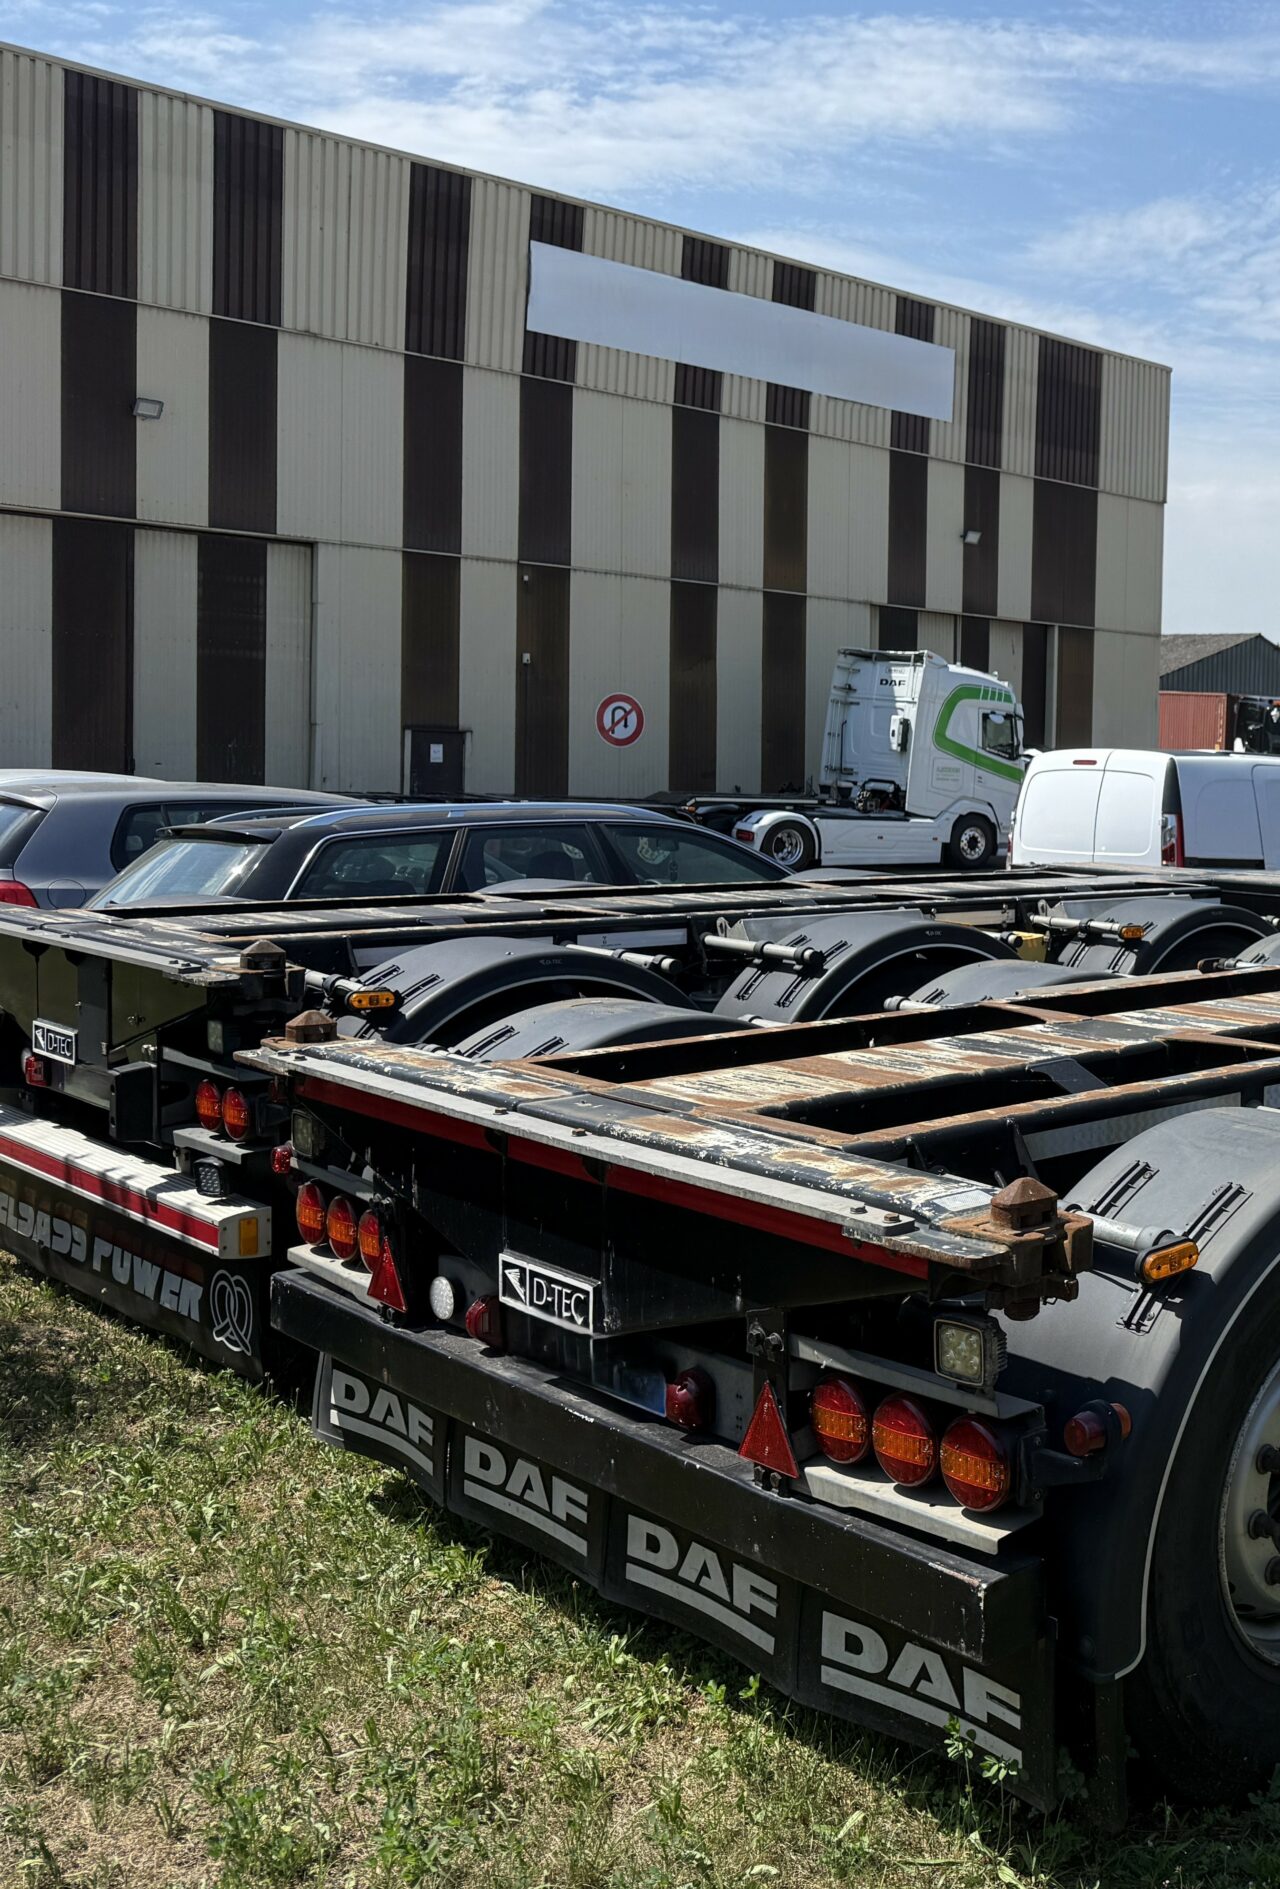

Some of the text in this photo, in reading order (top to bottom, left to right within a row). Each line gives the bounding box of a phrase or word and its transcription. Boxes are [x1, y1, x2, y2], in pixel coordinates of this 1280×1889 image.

[880, 679, 906, 687] DAF
[47, 1033, 72, 1056] D-TEC
[93, 1236, 203, 1322] POWER
[534, 1277, 586, 1325] D-TEC
[331, 1368, 434, 1447] DAF
[464, 1435, 589, 1524] DAF
[626, 1513, 778, 1608] DAF
[820, 1610, 1022, 1730] DAF
